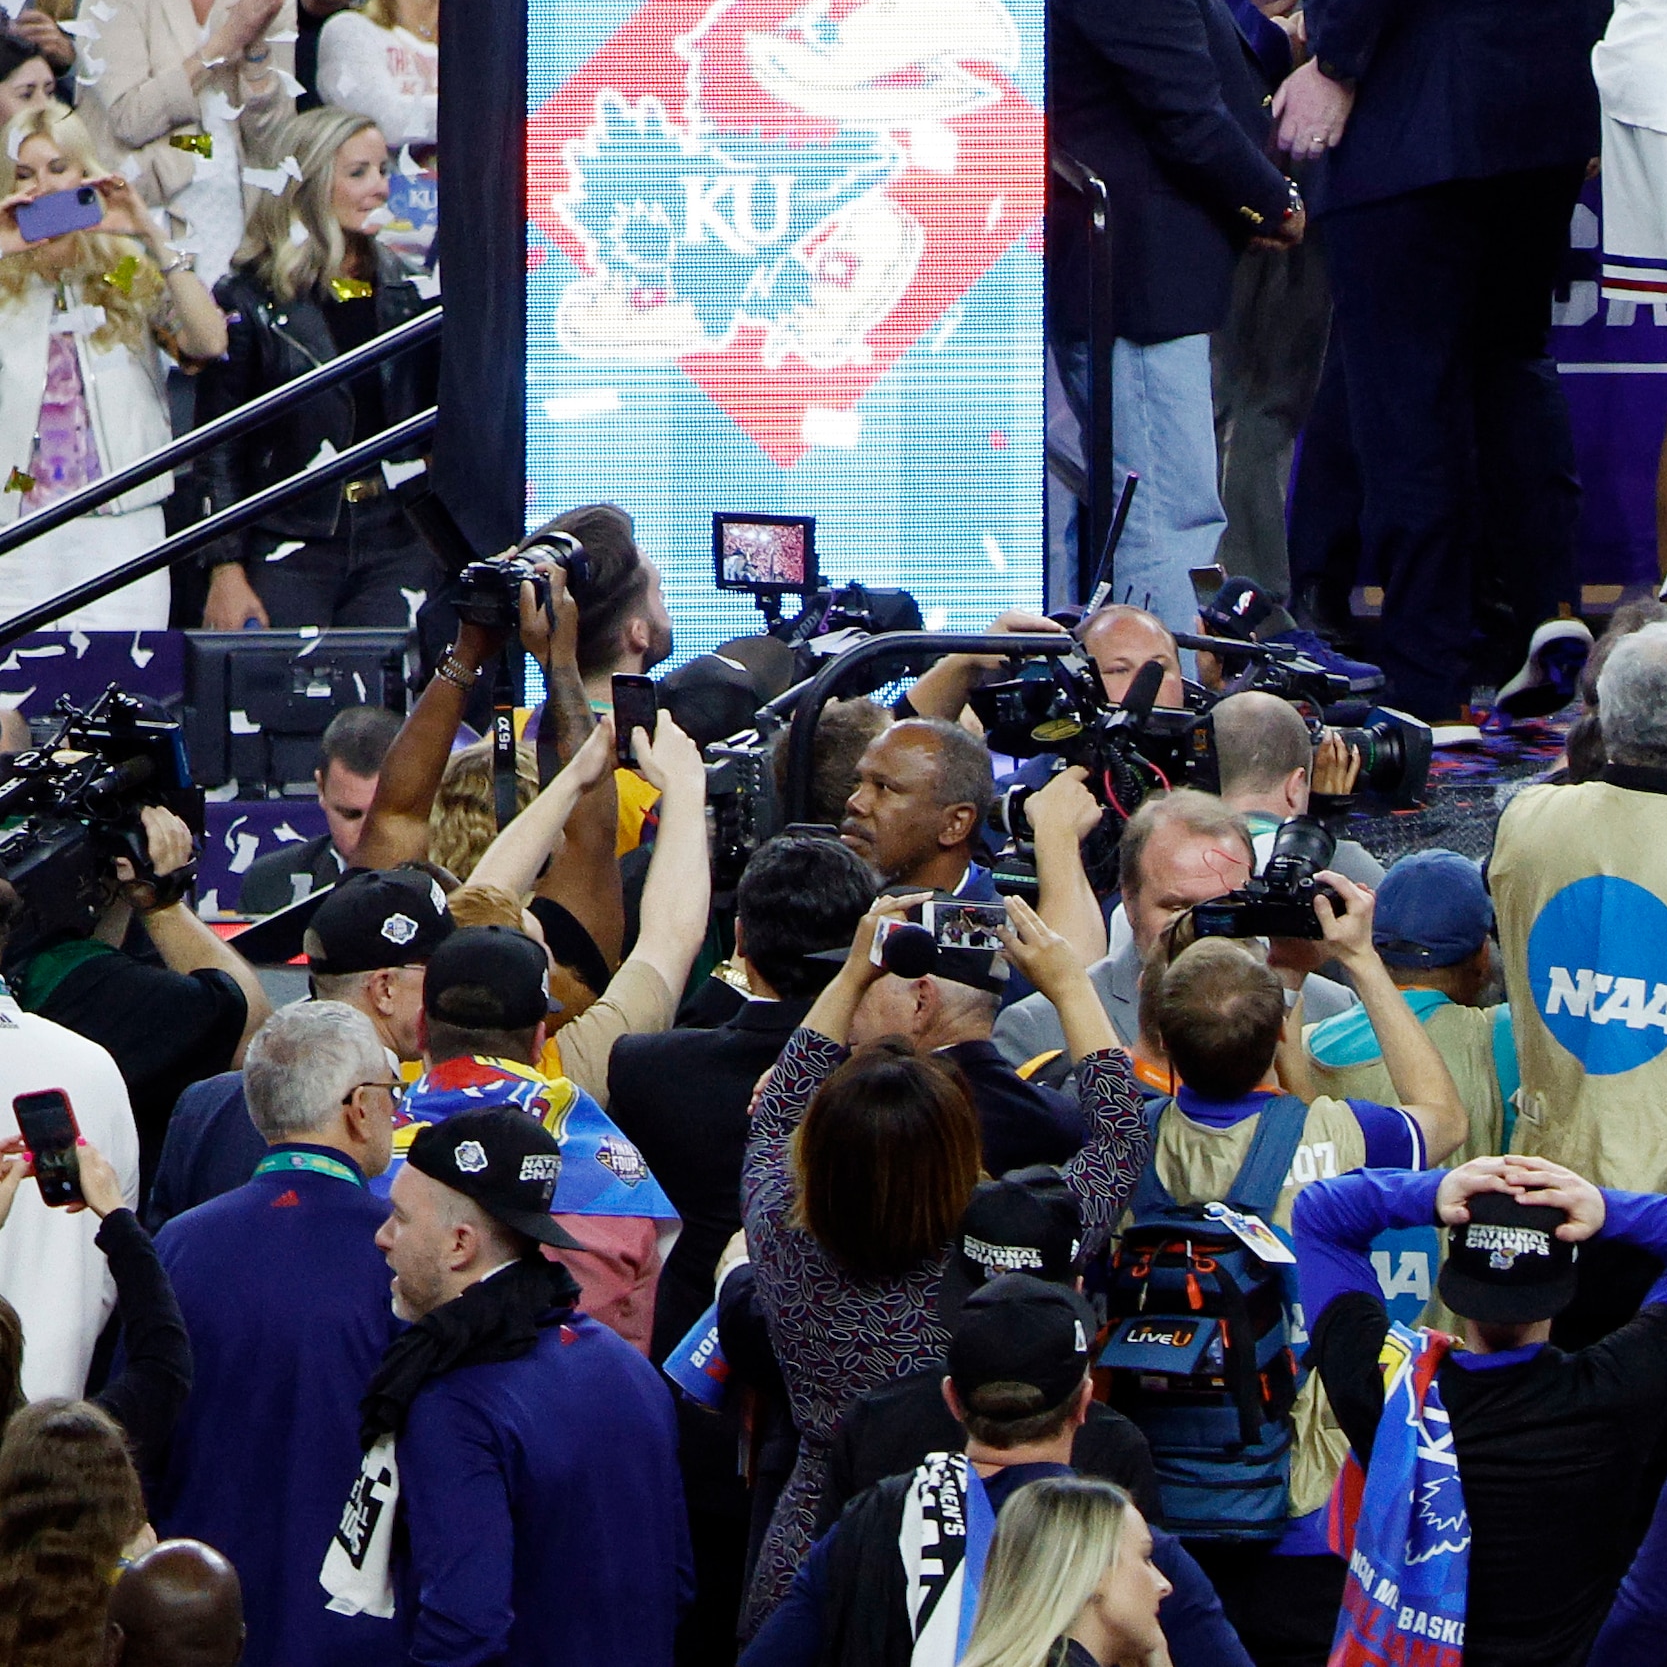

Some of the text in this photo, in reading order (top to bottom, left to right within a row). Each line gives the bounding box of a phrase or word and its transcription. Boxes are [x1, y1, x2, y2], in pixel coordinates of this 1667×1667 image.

[682, 172, 796, 254] KU
[1466, 1237, 1550, 1256] CHAMPS
[1397, 1604, 1464, 1647] BASKE
